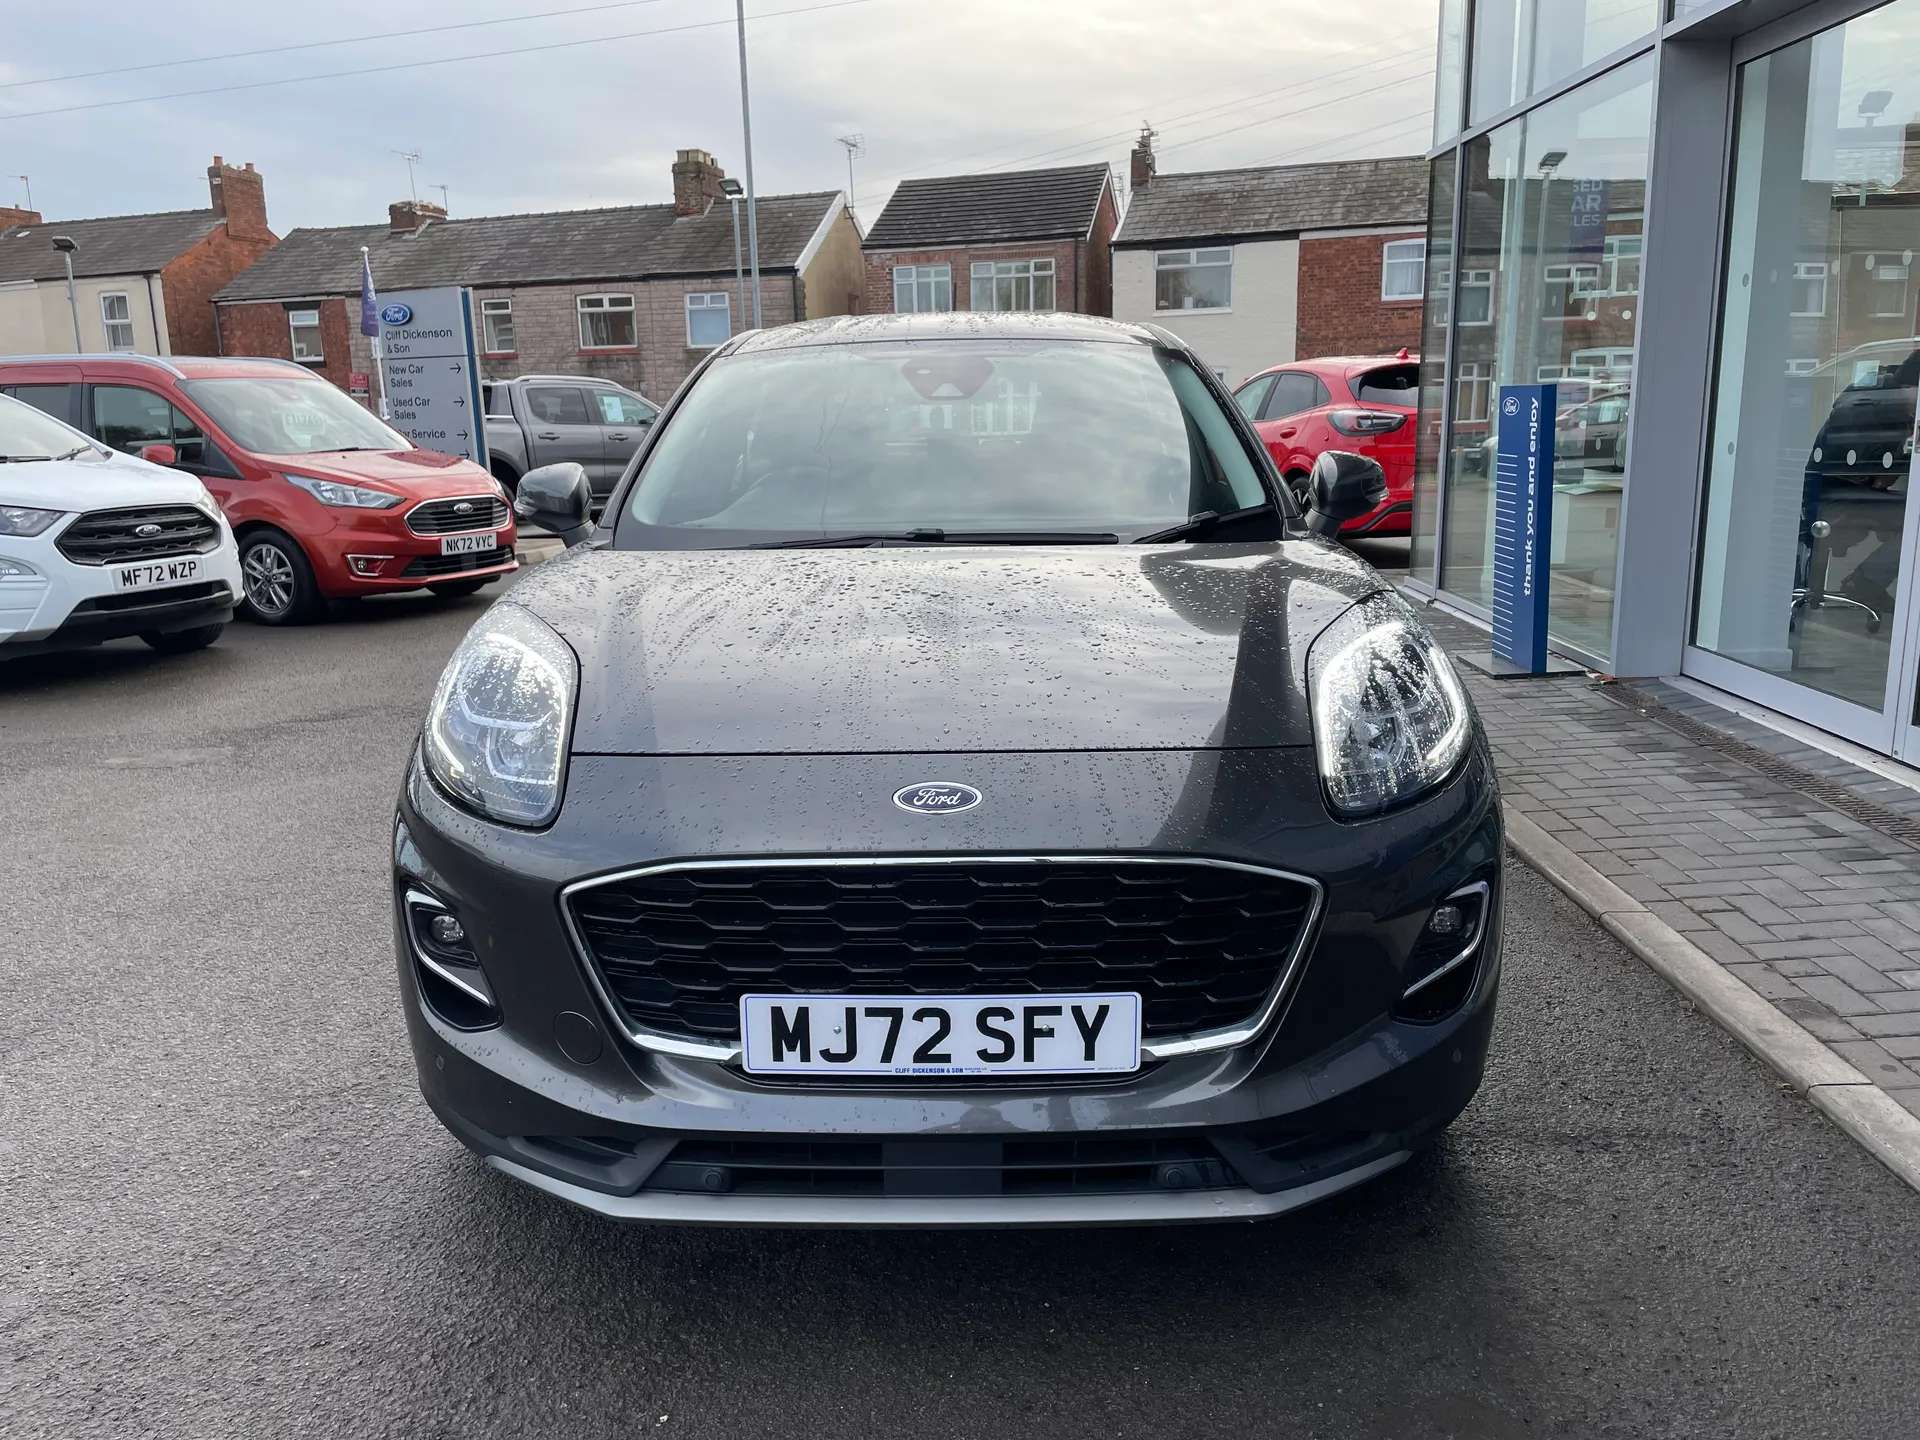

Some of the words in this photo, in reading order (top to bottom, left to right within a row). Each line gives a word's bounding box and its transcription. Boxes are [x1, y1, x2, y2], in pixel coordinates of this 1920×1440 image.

[385, 330, 400, 341] Cliff
[402, 329, 452, 339] Dickenson
[387, 344, 393, 353] &
[393, 344, 410, 353] Son
[389, 366, 406, 374] New
[408, 364, 423, 374] Car
[390, 377, 413, 388] Sales
[392, 397, 413, 407] Used
[414, 396, 431, 407] Car
[394, 410, 416, 420] Sales
[1529, 397, 1539, 453] enjoy
[411, 428, 446, 439] Service
[1528, 457, 1536, 495] and
[446, 538, 473, 552] NK72
[475, 535, 493, 548] VYC
[121, 565, 165, 586] MF72
[168, 561, 197, 580] WZP
[1523, 539, 1532, 596] thank
[913, 788, 961, 805] Ford
[770, 1006, 952, 1064] MJ72
[976, 1004, 1110, 1063] SFY
